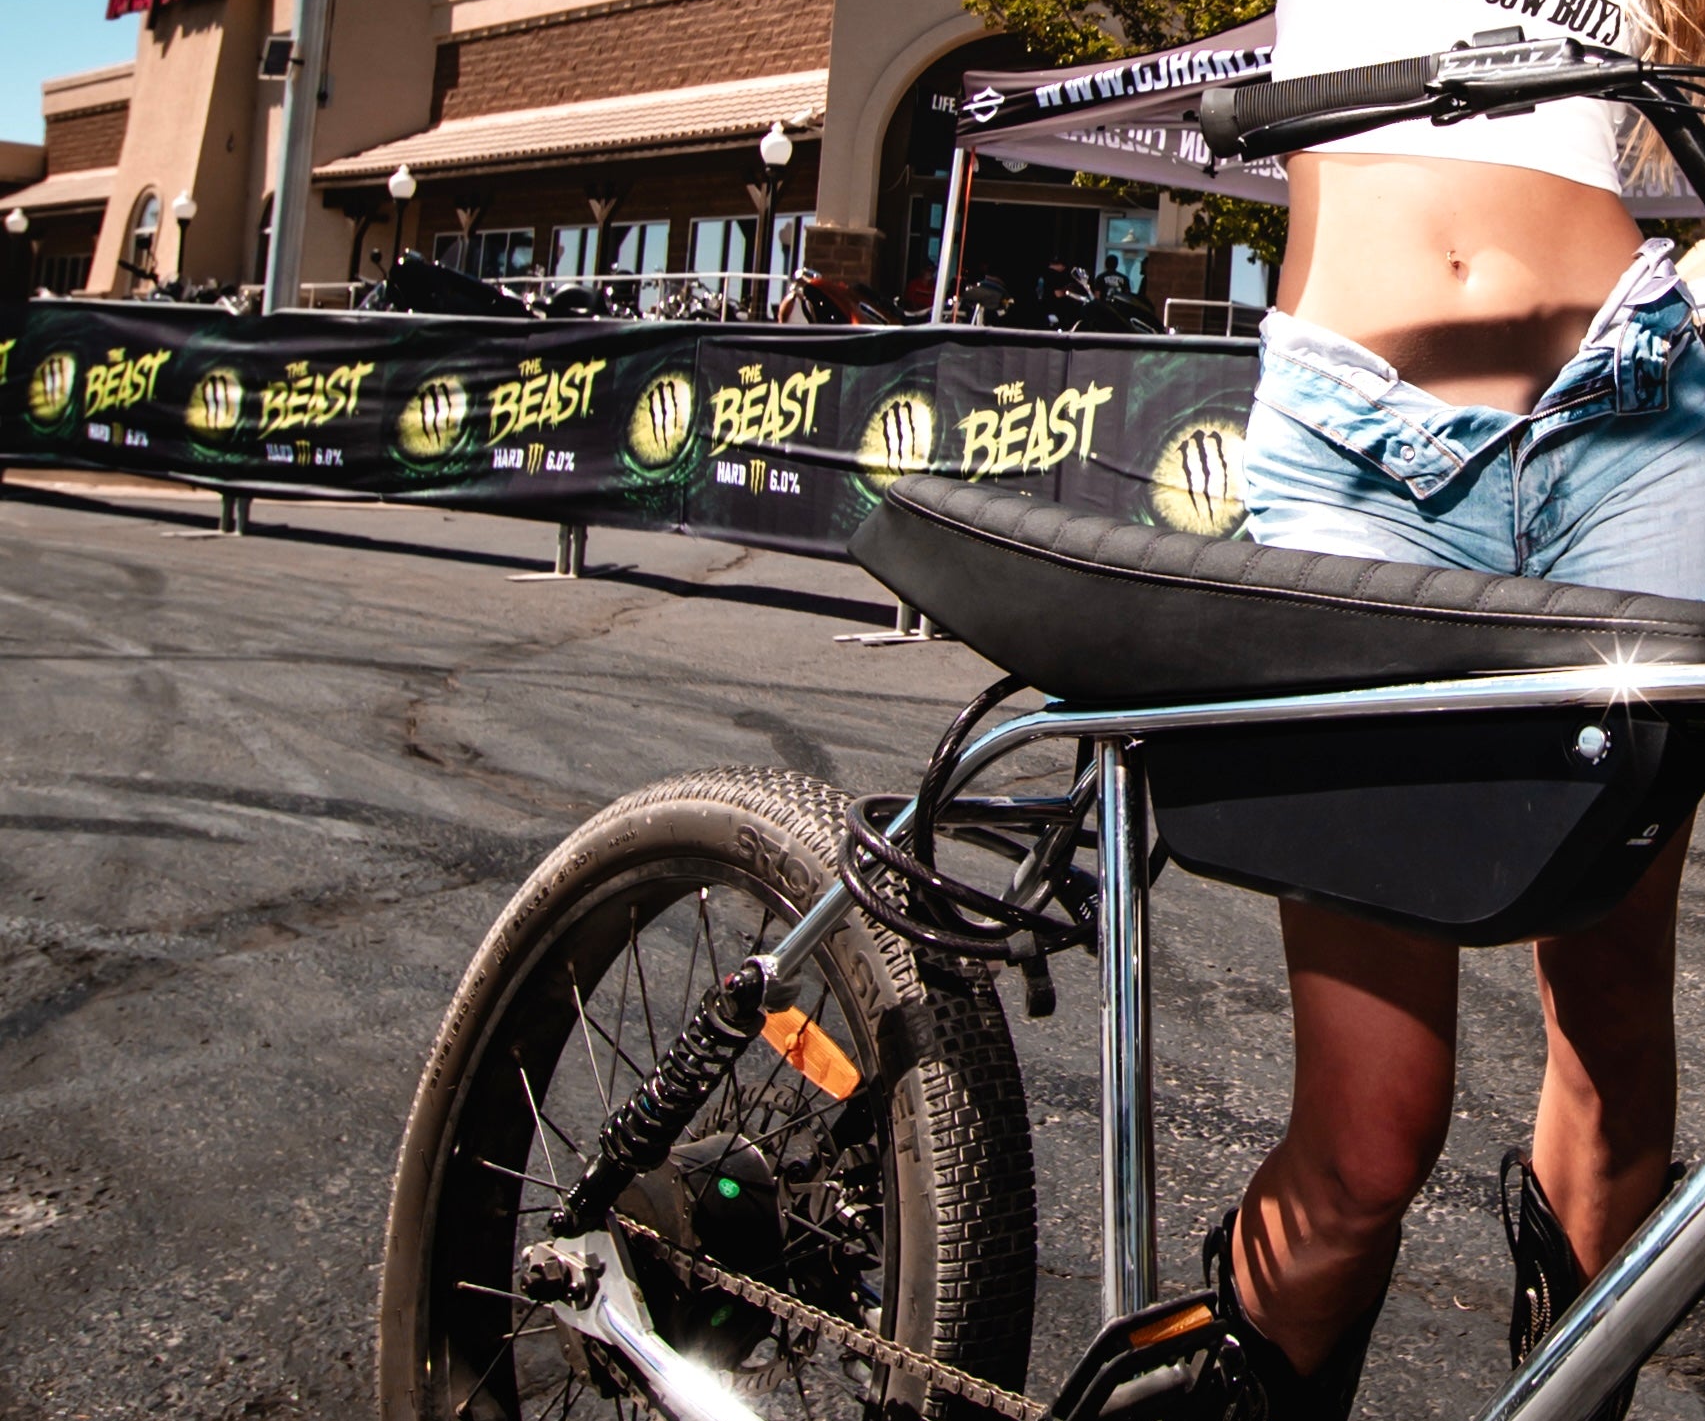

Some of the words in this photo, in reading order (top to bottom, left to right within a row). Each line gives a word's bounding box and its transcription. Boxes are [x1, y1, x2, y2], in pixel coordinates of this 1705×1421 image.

[85, 348, 173, 419] BEAST
[284, 360, 310, 379] THE
[517, 357, 543, 377] THE
[737, 363, 764, 385] THE
[258, 360, 376, 441] BEAST
[484, 356, 608, 448] BEAST
[992, 380, 1026, 406] THE
[707, 364, 833, 458] BEAST
[953, 380, 1115, 483] BEAST
[493, 448, 525, 469] HARD
[546, 450, 576, 472] 6.0%
[716, 461, 747, 487] HARD
[769, 468, 801, 495] 6.0%
